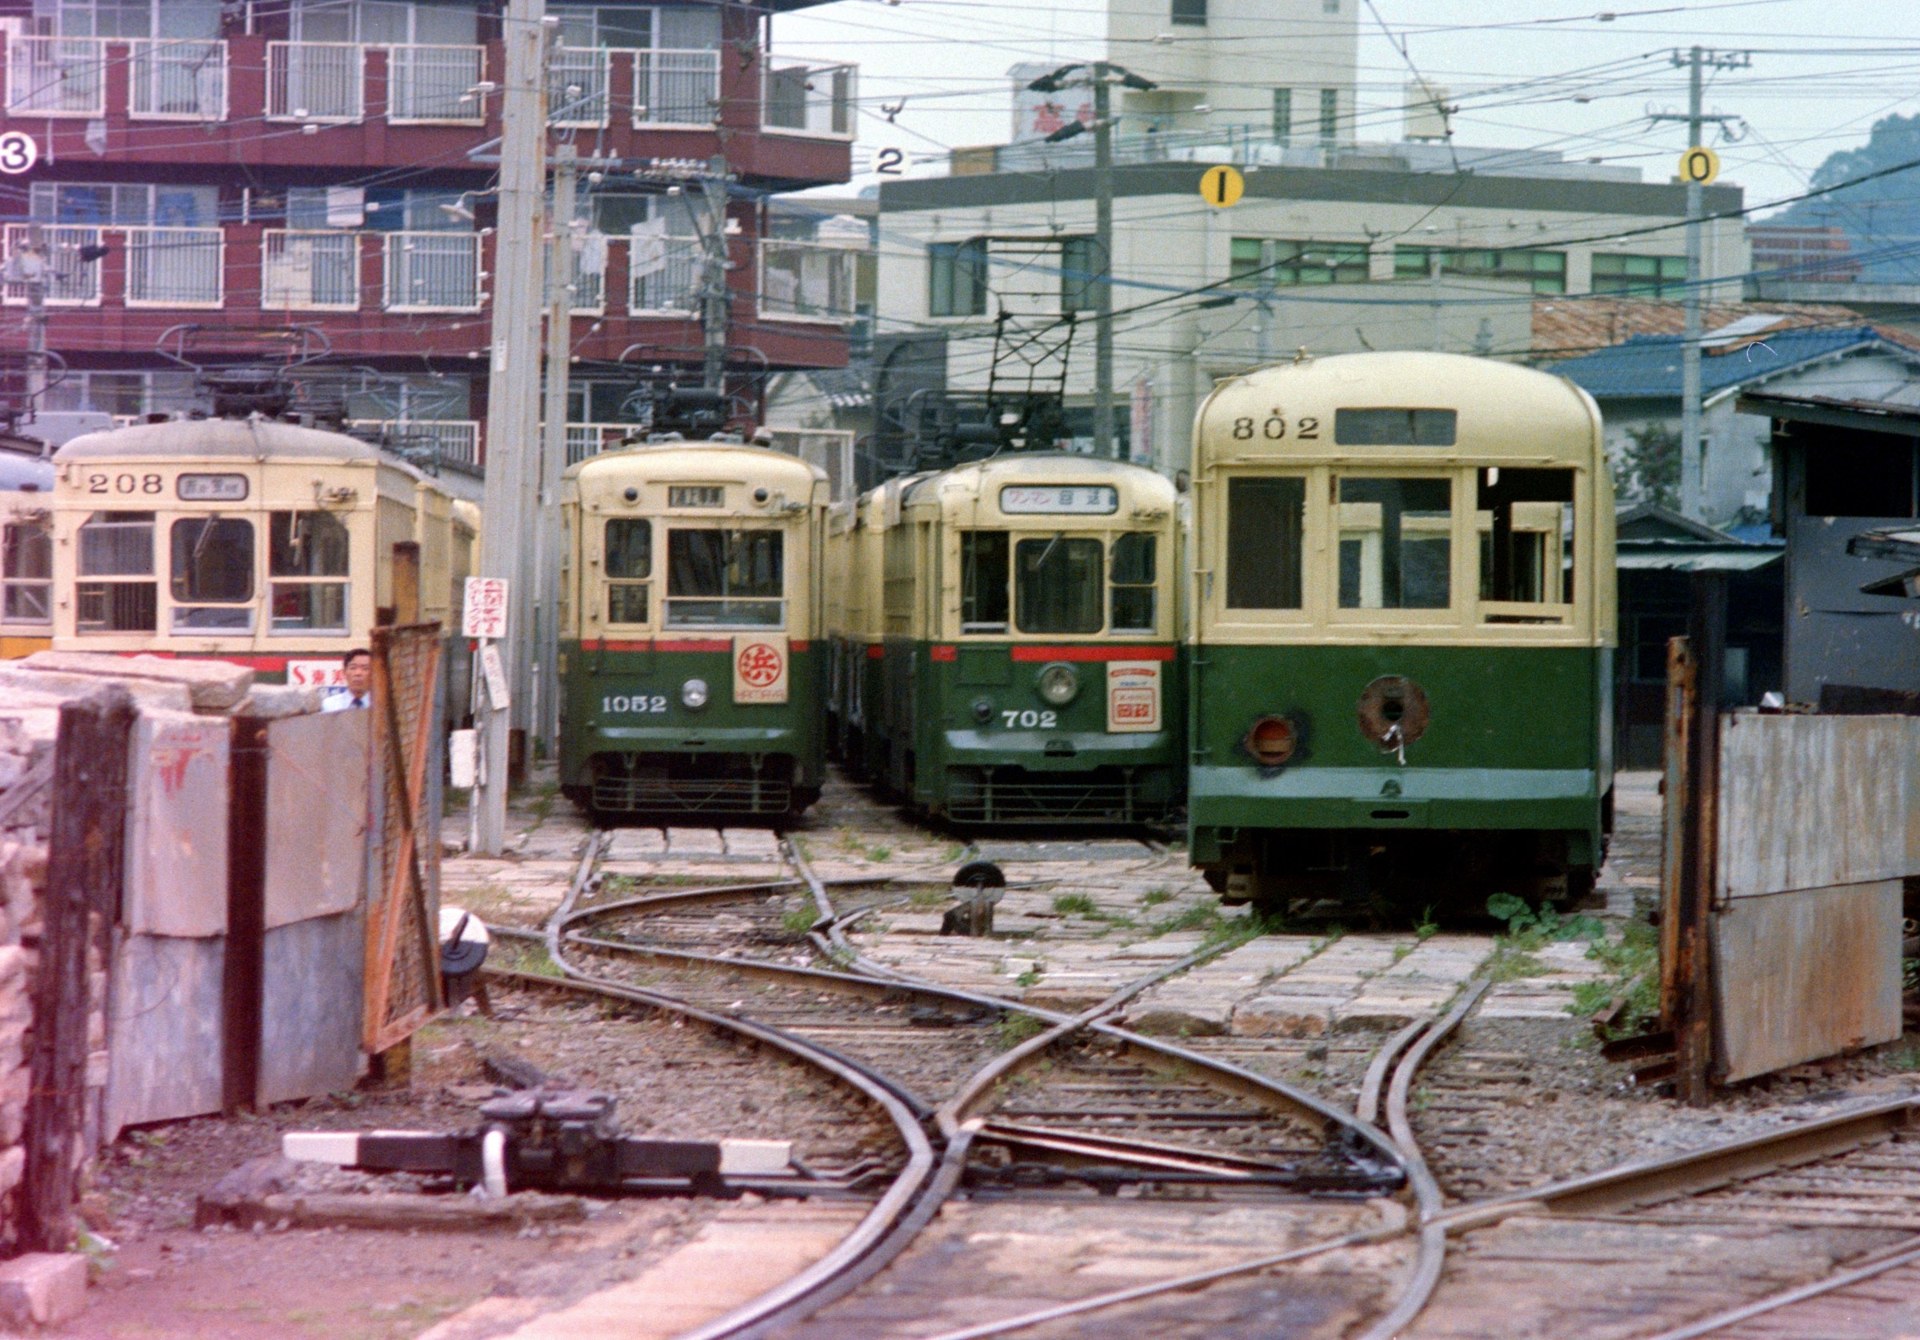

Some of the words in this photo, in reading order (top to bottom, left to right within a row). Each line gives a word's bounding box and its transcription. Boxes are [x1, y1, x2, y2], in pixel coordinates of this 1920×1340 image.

[1, 137, 29, 170] 3
[877, 148, 903, 174] 2
[1688, 152, 1710, 181] 0
[1232, 417, 1320, 440] 802
[89, 473, 163, 494] 208
[602, 695, 668, 713] 1052
[1001, 710, 1058, 728] 702
